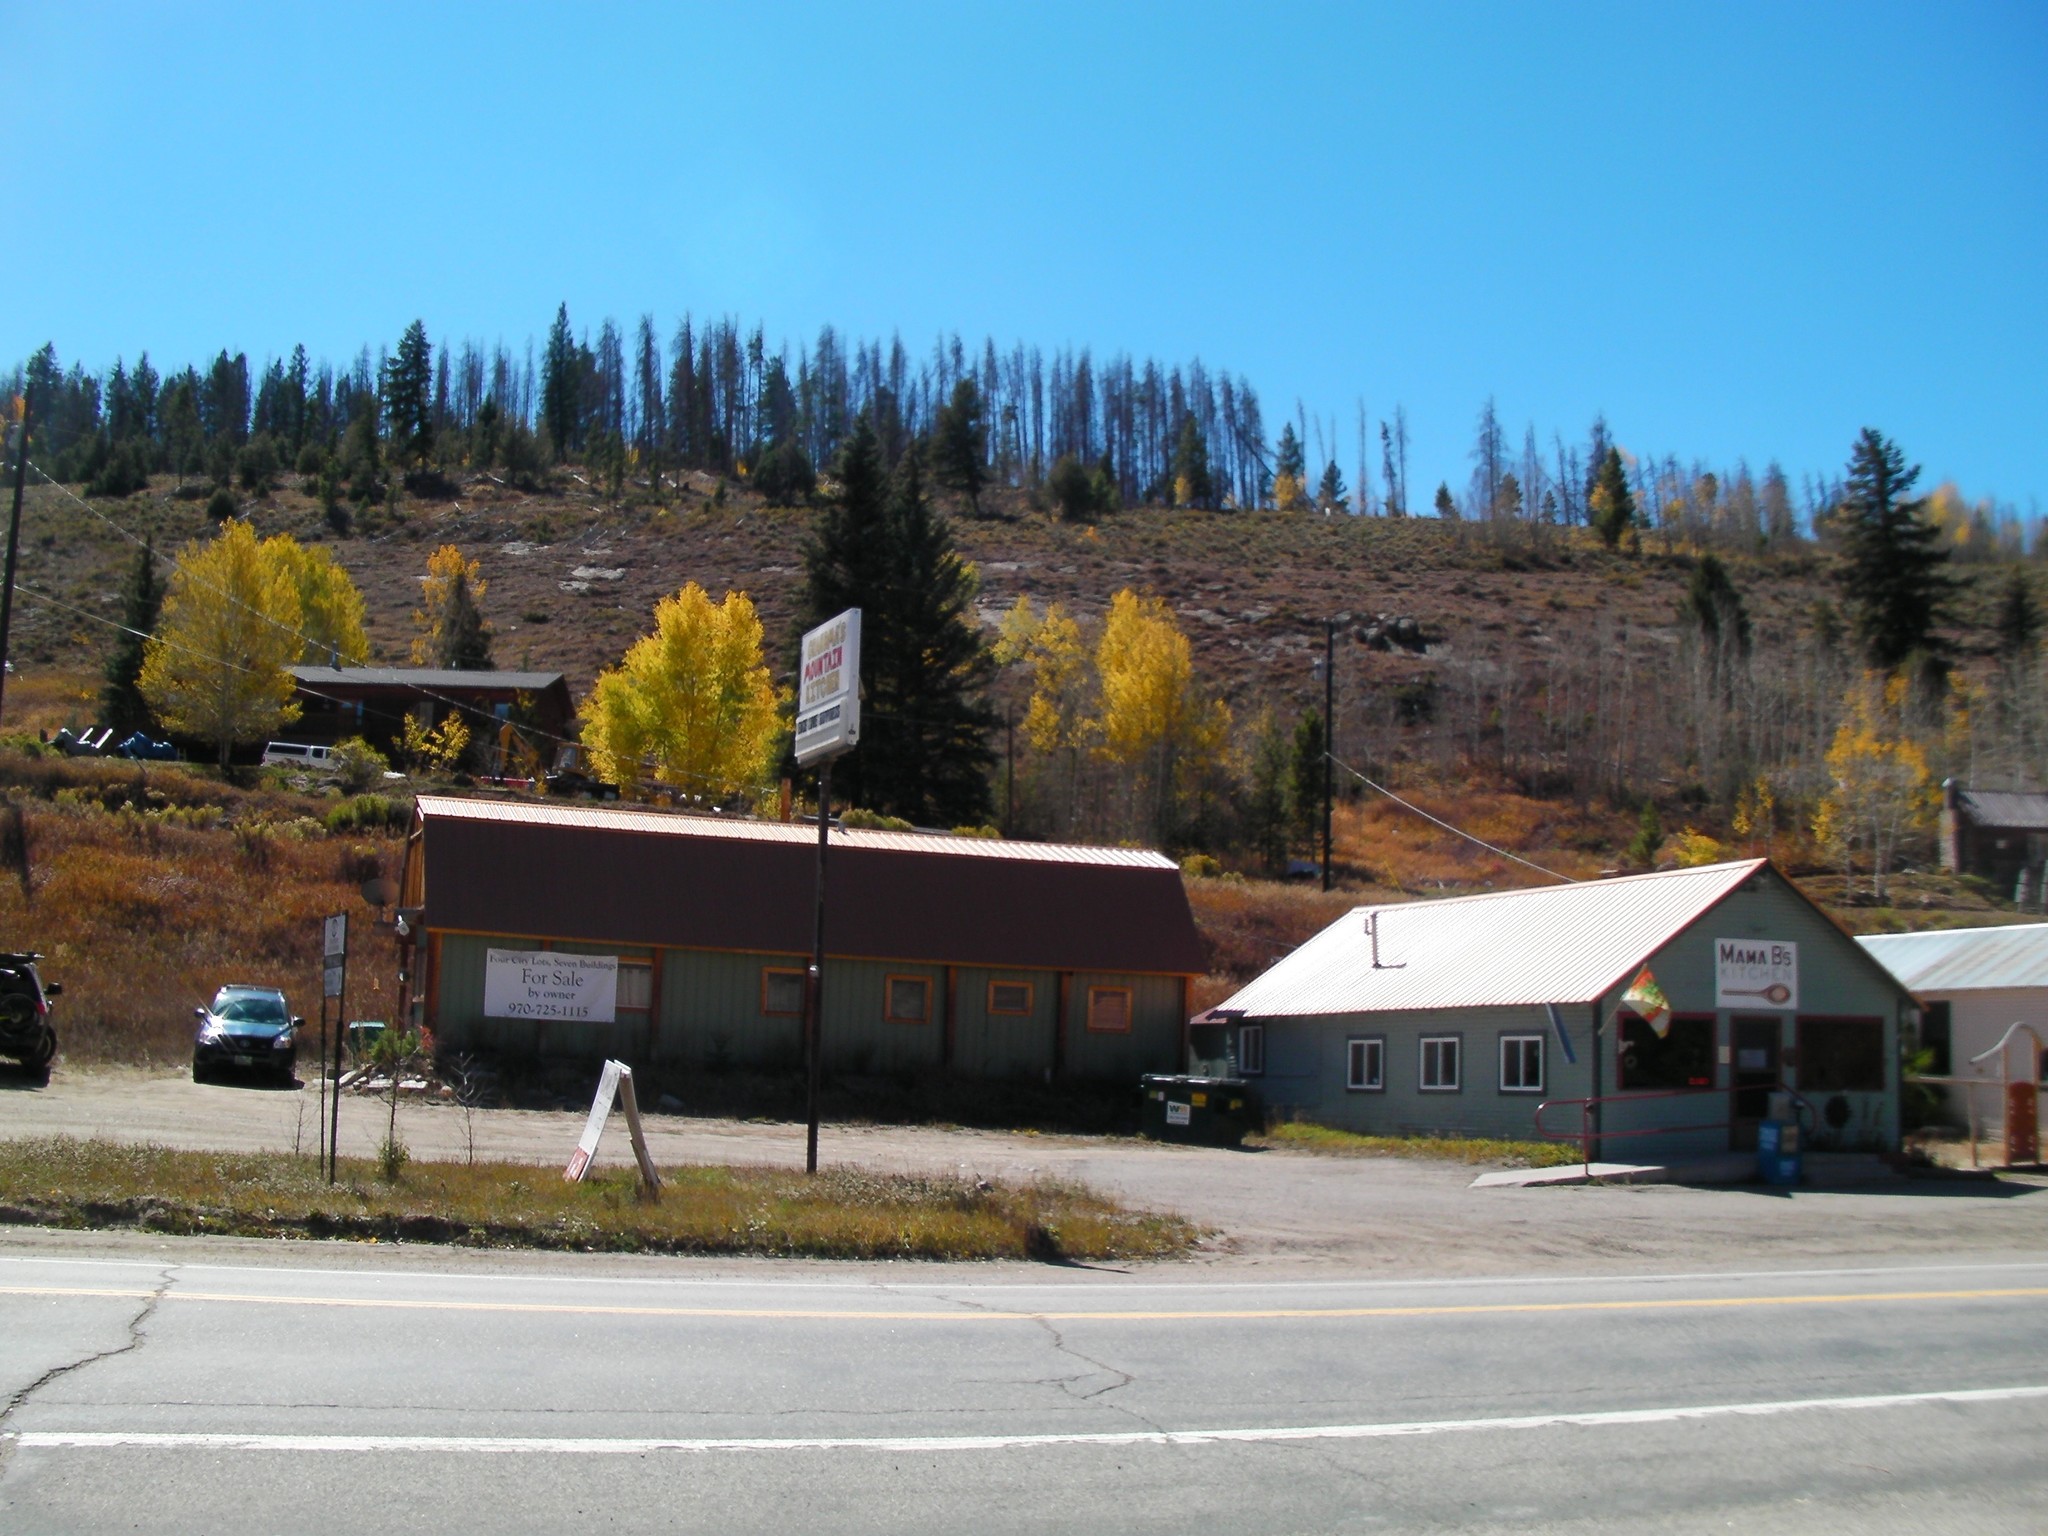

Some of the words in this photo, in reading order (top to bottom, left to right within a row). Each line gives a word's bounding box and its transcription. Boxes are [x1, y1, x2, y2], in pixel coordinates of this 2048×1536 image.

[490, 955, 509, 963] Four
[512, 956, 529, 965] City
[554, 959, 577, 968] Seven
[580, 960, 616, 971] Buildings
[522, 968, 548, 984] For
[552, 971, 584, 987] Sale
[1720, 966, 1793, 980] KITCHEN
[528, 987, 540, 998] by
[543, 991, 576, 1000] owner
[508, 1003, 589, 1017] 970-725-1115
